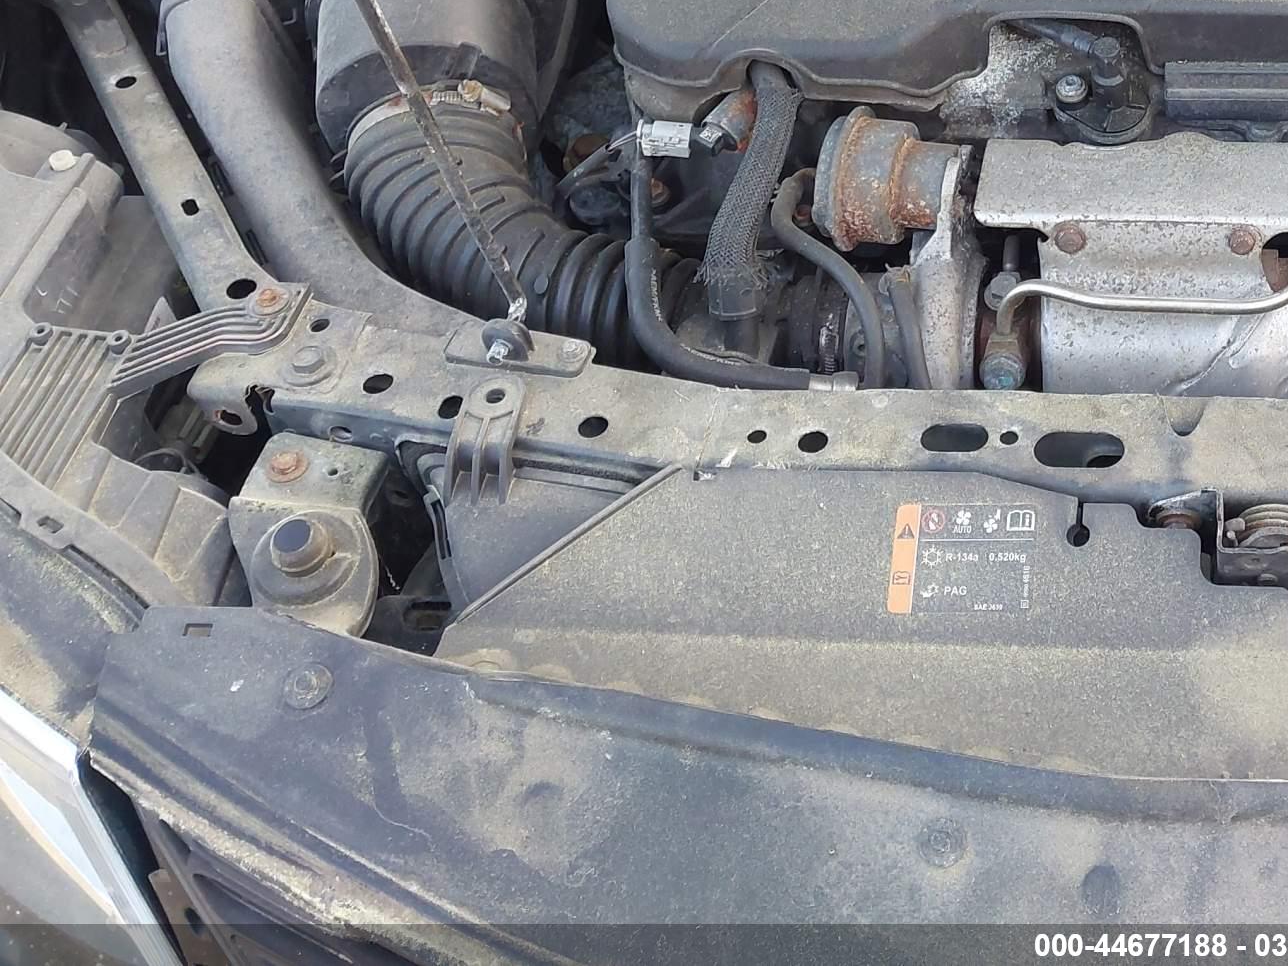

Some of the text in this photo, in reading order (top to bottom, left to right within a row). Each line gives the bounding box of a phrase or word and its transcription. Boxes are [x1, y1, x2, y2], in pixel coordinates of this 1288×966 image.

[953, 525, 972, 534] AUTO
[945, 552, 1027, 563] R-134a 0.520kg
[943, 585, 968, 596] PAG
